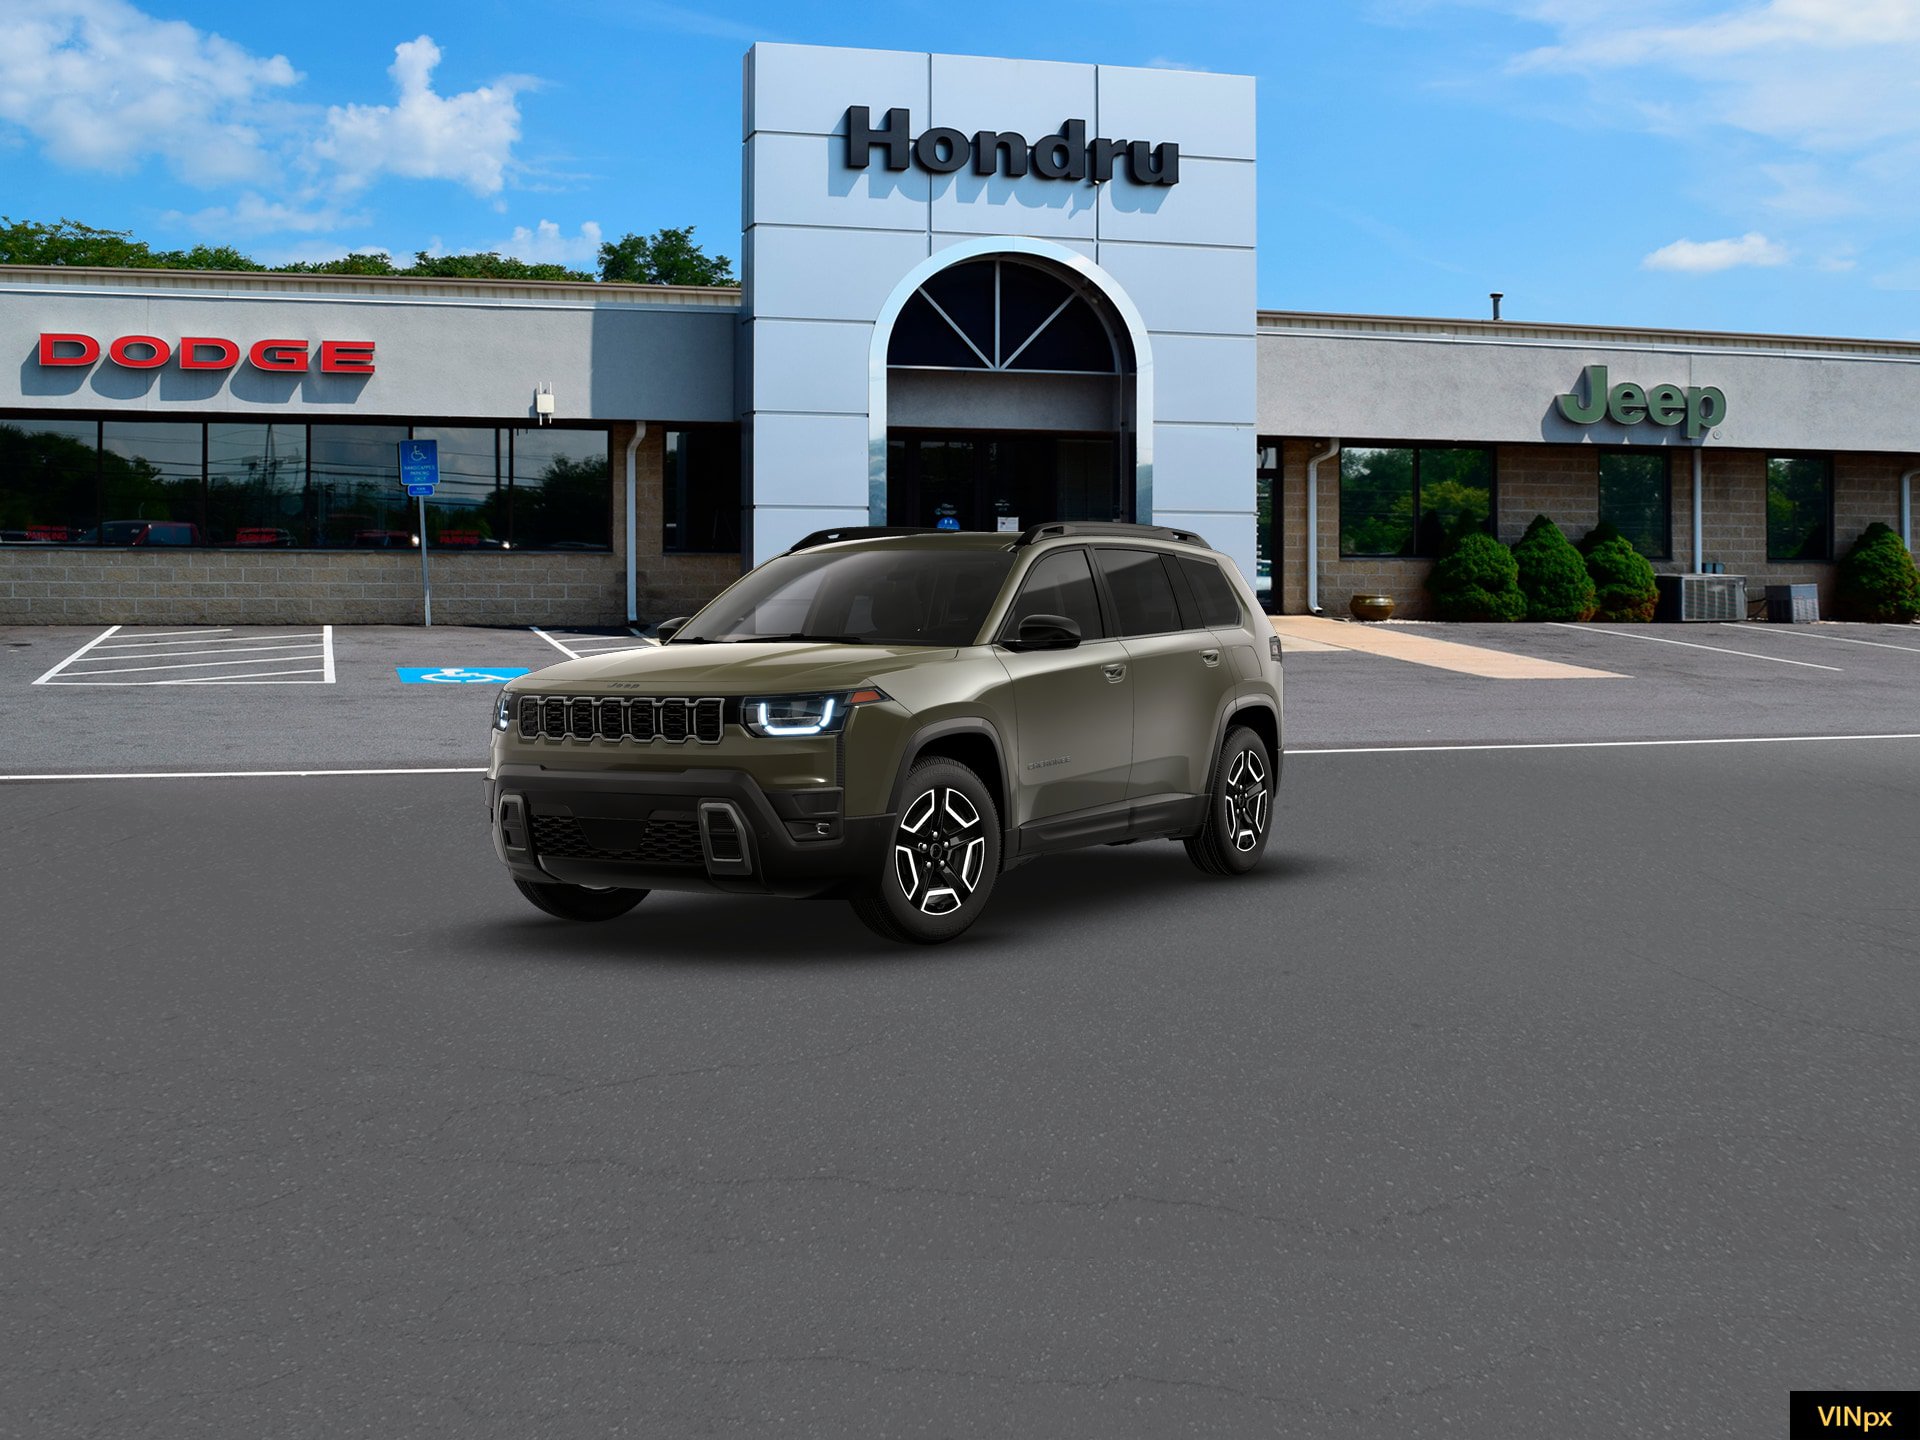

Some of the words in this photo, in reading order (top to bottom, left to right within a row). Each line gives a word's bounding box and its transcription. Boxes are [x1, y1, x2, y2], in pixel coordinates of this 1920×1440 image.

[847, 105, 1180, 185] Hondru
[38, 332, 376, 374] DODGE
[1555, 365, 1727, 439] Jeep
